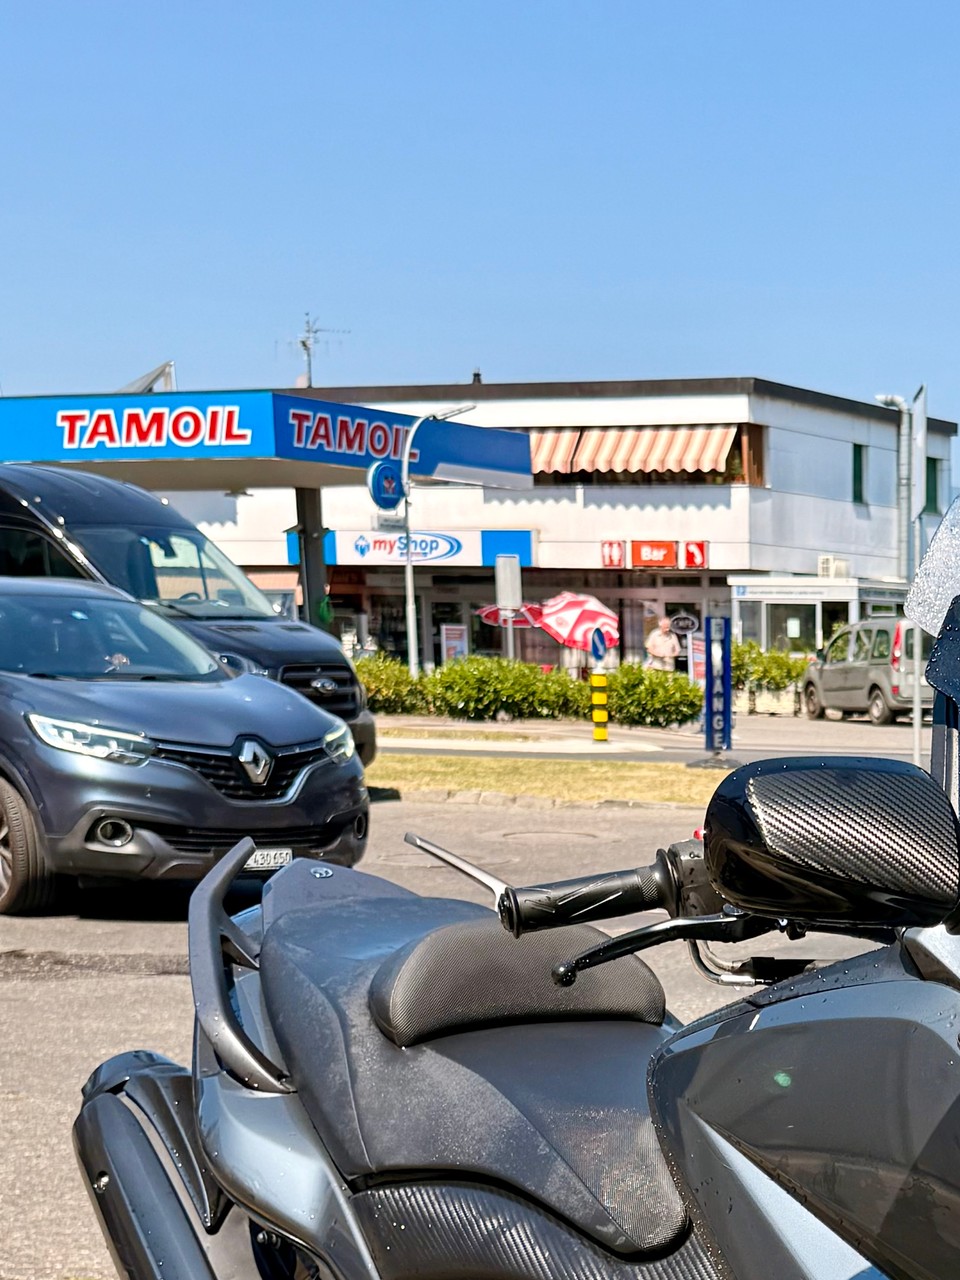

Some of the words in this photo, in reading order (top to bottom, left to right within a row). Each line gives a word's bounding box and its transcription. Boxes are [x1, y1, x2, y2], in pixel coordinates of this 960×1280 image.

[57, 407, 251, 448] TAMOIL
[372, 536, 439, 555] myShop
[641, 545, 667, 561] Bar
